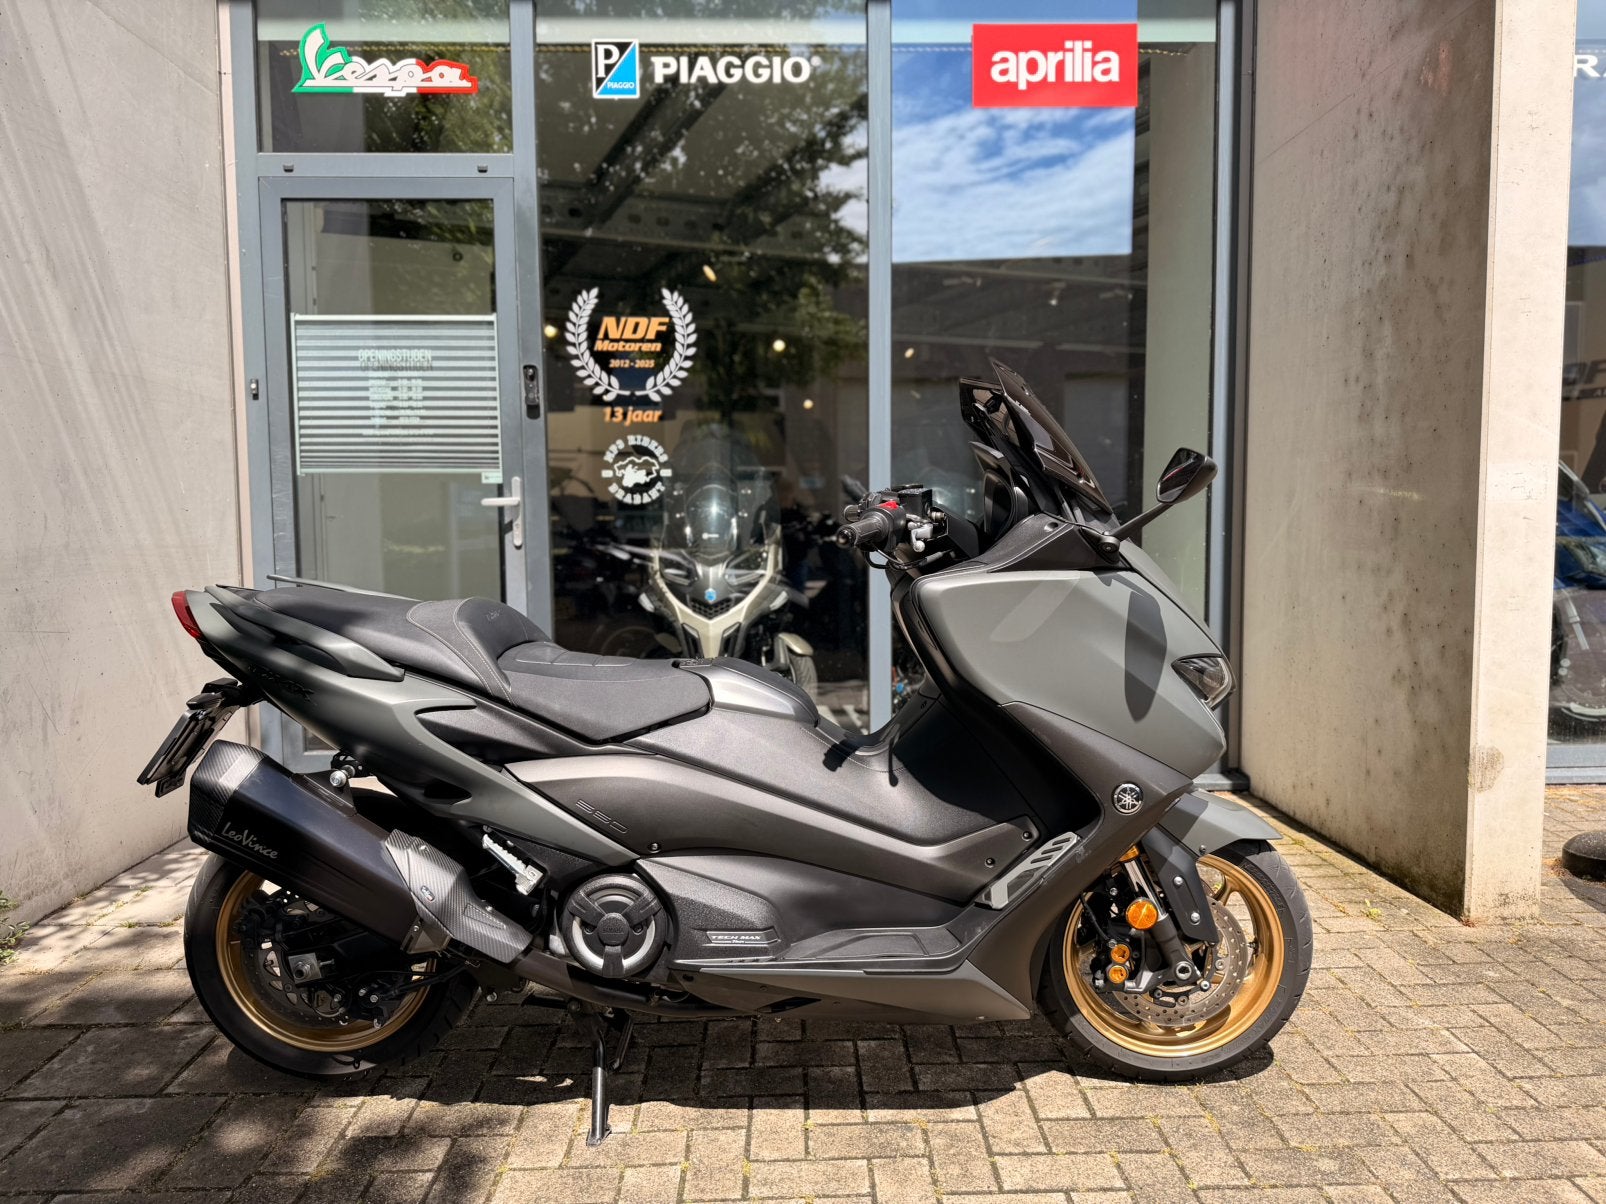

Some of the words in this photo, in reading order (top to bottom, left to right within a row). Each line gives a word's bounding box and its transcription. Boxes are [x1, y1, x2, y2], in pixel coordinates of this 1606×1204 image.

[299, 26, 474, 93] Vespa
[990, 40, 1120, 90] aprilia
[606, 80, 635, 90] PIAGGIO
[597, 316, 670, 340] NDF
[593, 340, 662, 352] Motoren
[609, 359, 630, 368] 2012
[635, 359, 656, 368] 2025
[603, 406, 624, 422] 13
[624, 406, 662, 426] jaar
[627, 434, 669, 463] RIDERS
[607, 481, 666, 505] BRABANT
[221, 821, 279, 859] LeoVince
